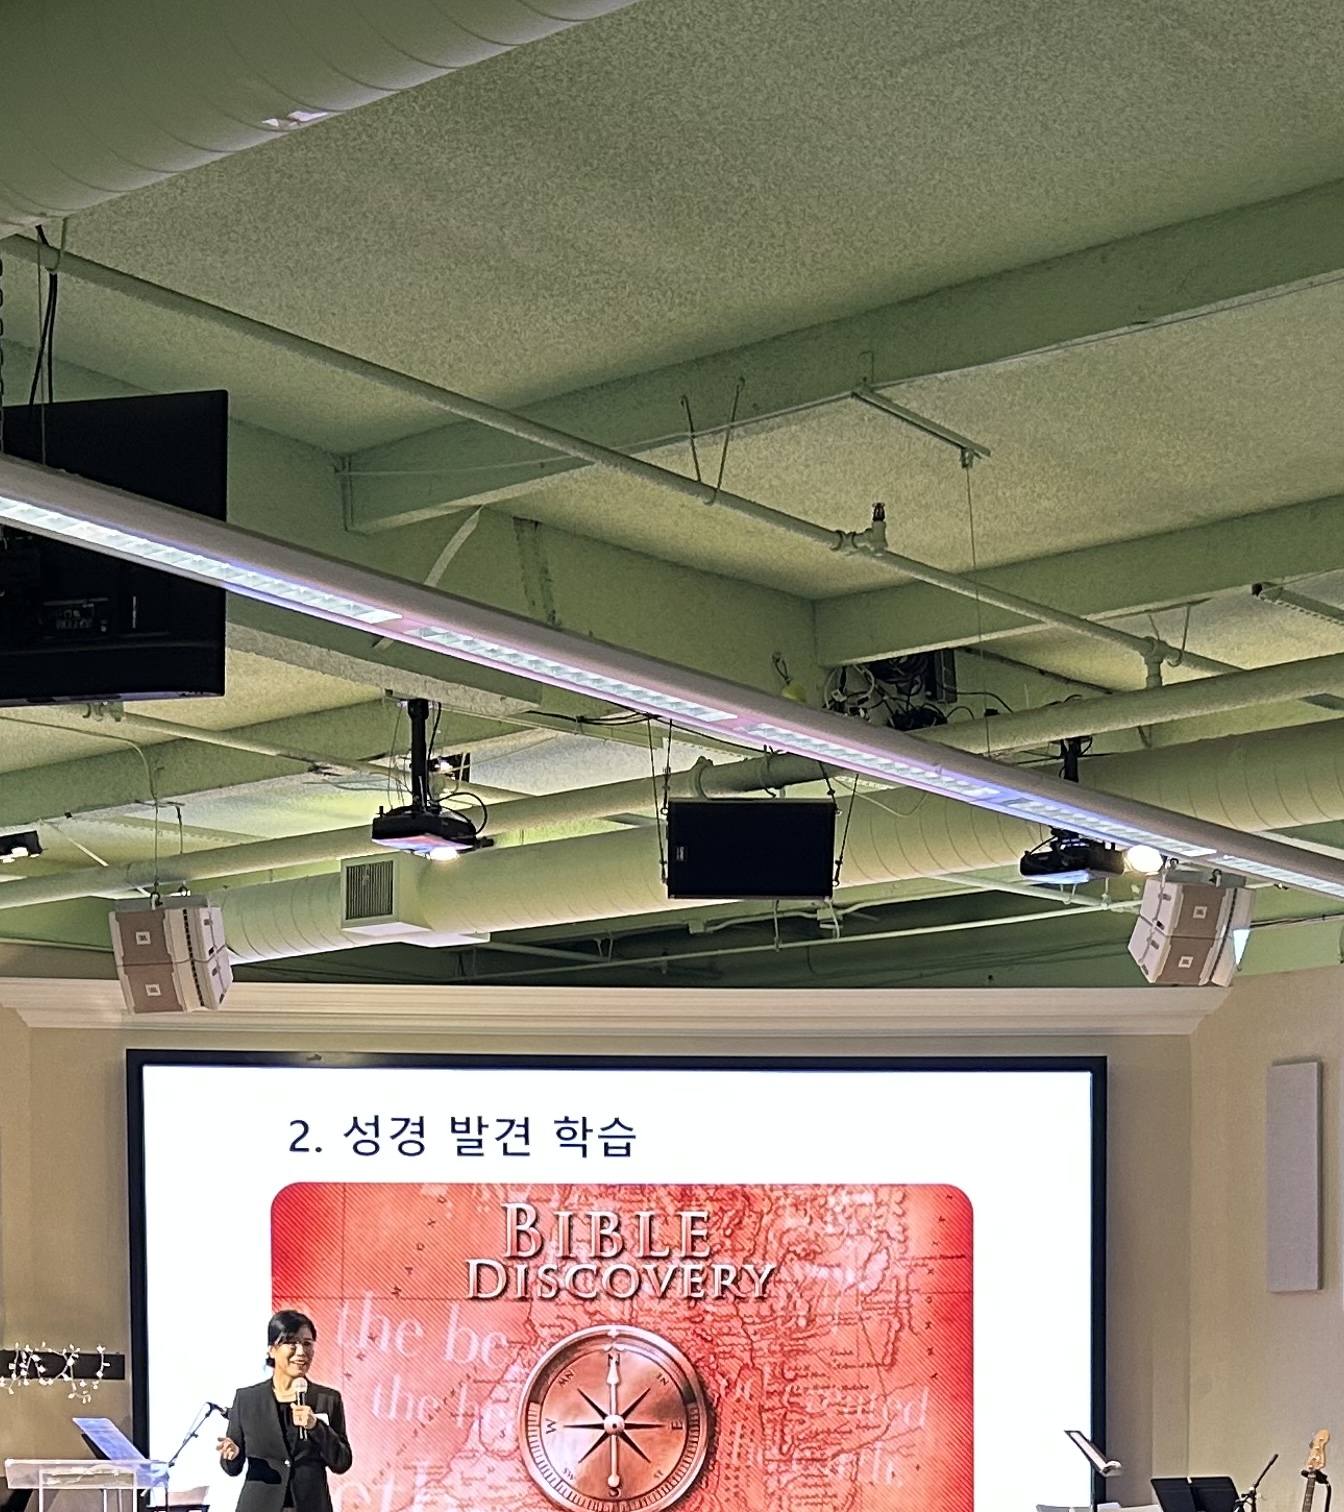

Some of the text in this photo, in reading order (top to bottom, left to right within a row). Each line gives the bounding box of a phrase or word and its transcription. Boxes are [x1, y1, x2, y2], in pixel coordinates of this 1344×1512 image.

[288, 1114, 637, 1159] 2. 성경 발견 학습
[500, 1200, 713, 1260] BIBLE
[465, 1257, 777, 1300] DISCOVERY
